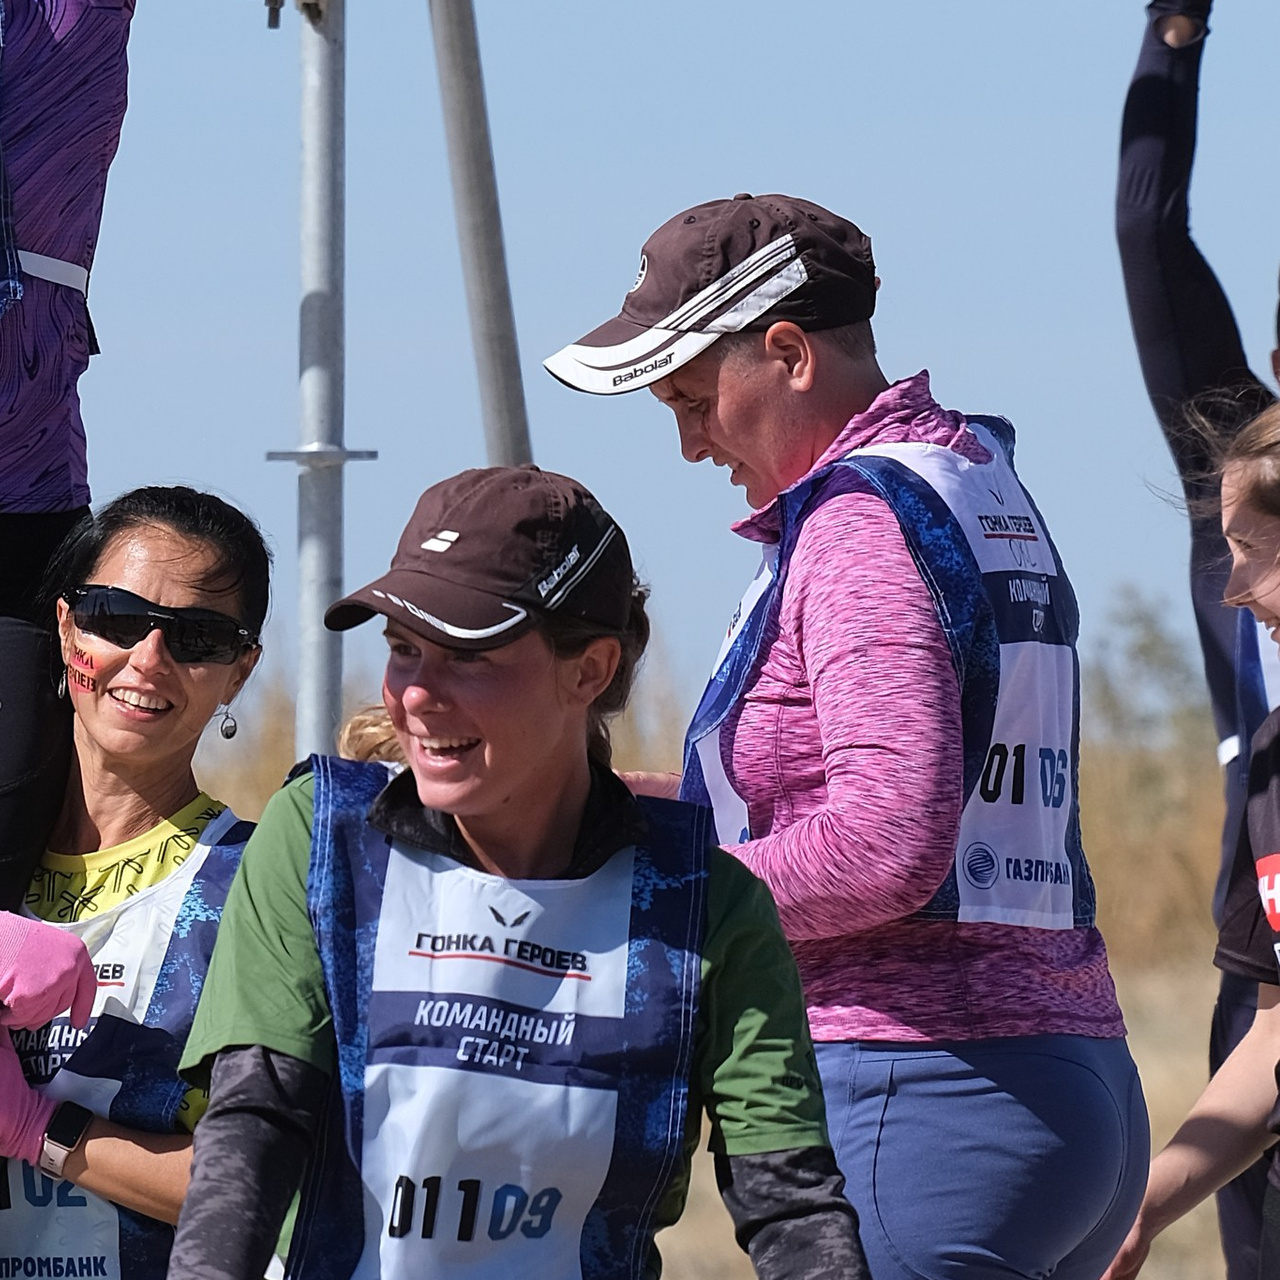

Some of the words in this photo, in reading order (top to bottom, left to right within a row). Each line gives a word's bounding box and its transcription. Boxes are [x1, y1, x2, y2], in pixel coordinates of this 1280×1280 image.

[416, 933, 495, 953] ГОНКА
[504, 938, 587, 971] ГЕРОЕВ
[414, 1000, 576, 1046] КОМАНДНЫЙ
[456, 1036, 529, 1071] СТАРТ
[388, 1175, 563, 1242] 01109
